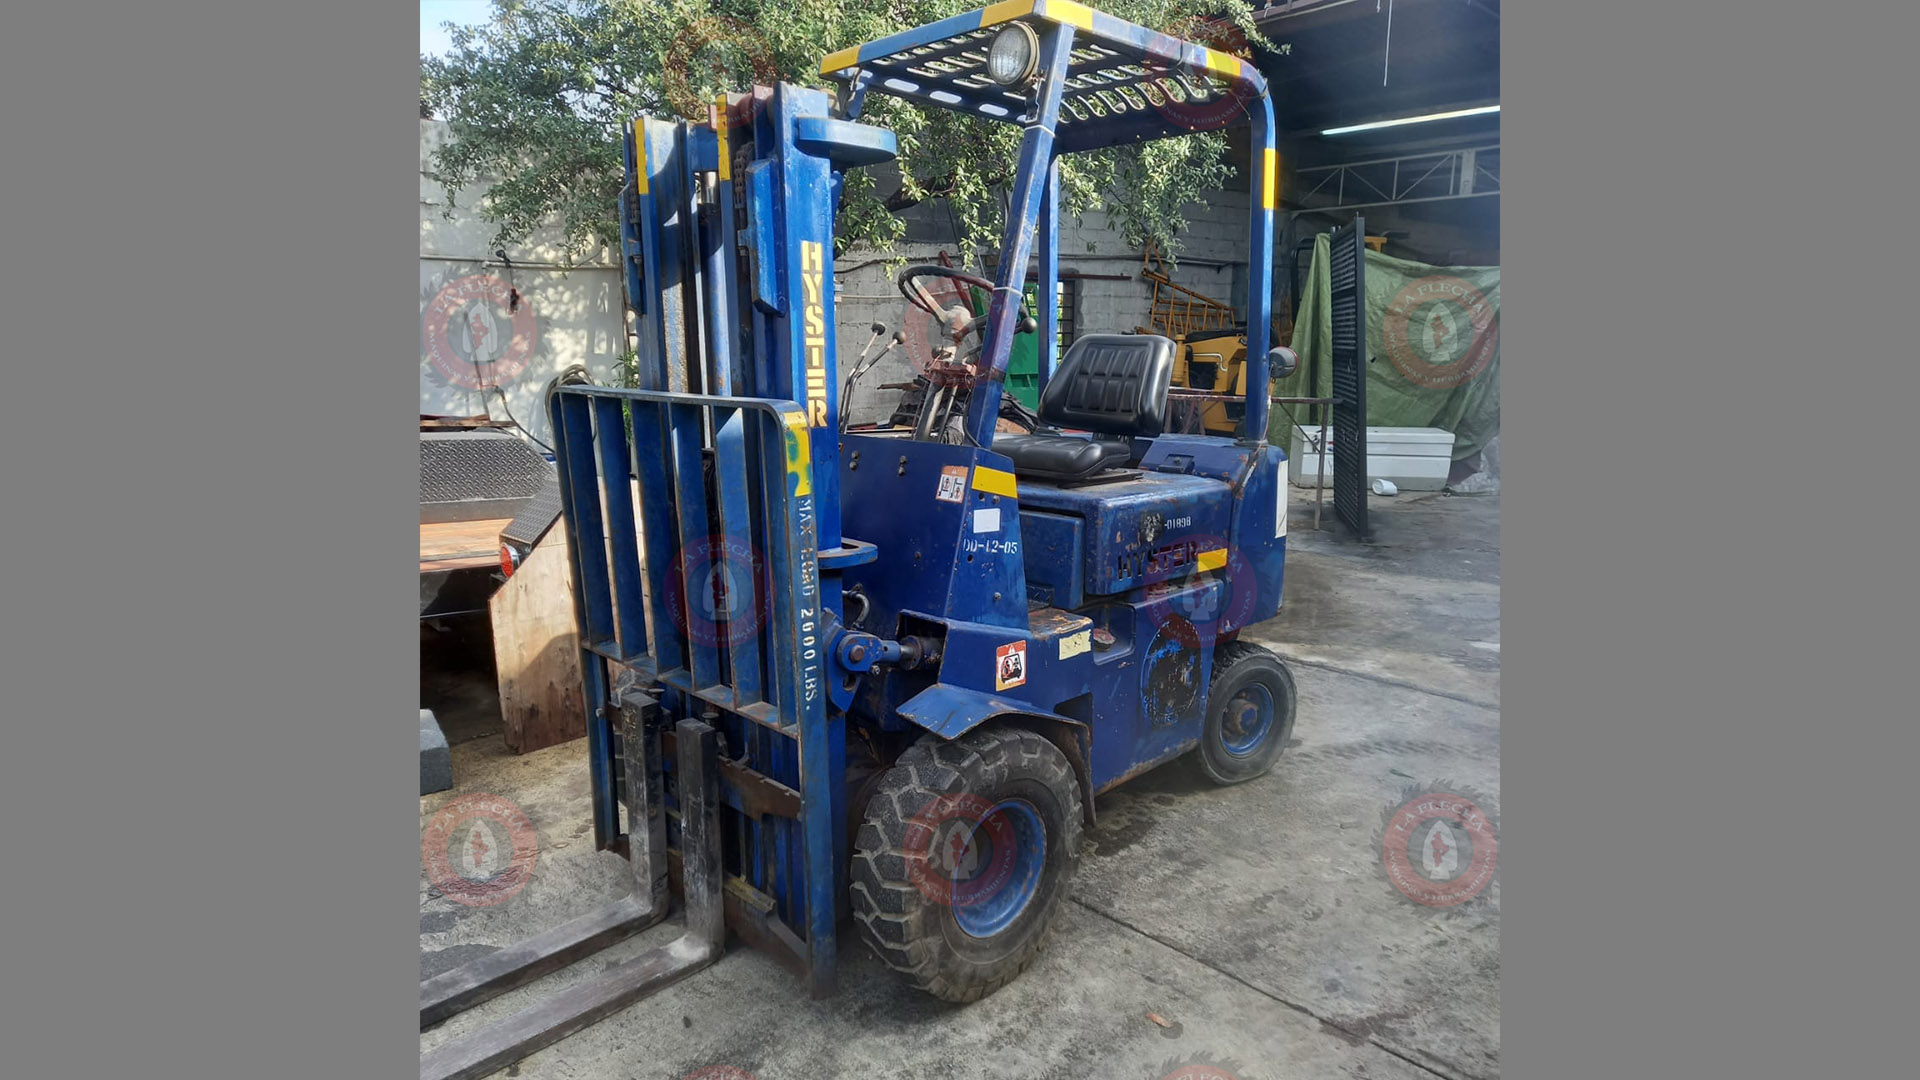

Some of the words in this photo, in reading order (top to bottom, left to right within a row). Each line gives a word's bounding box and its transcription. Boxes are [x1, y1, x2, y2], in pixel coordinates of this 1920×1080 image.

[802, 240, 828, 427] HYSTER
[799, 499, 813, 536] MAX
[1118, 541, 1198, 581] HYSTER
